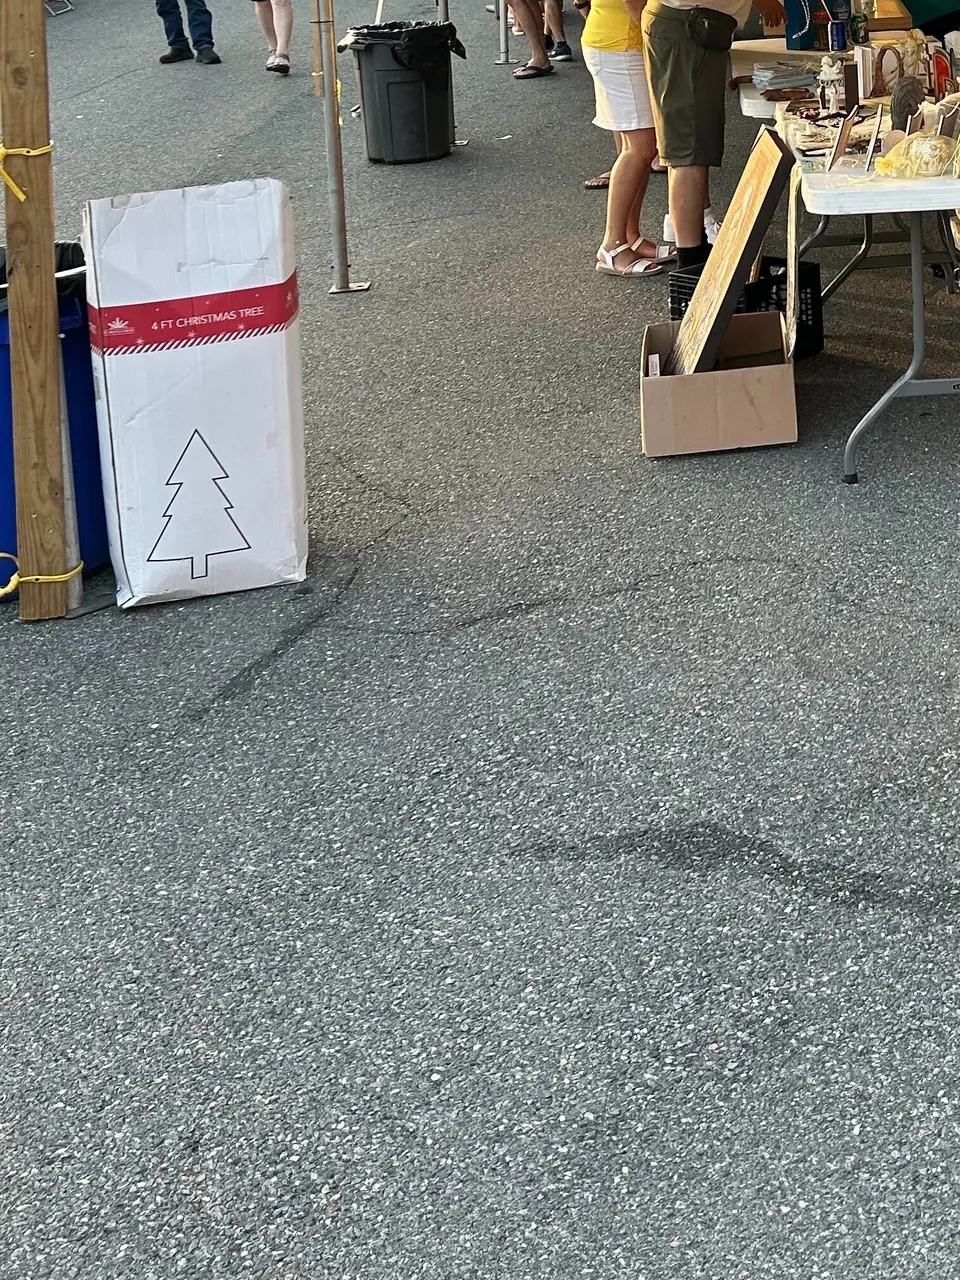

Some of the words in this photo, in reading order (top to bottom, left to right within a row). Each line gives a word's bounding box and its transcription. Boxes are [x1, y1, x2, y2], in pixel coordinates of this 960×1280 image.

[151, 322, 158, 331] 4
[161, 319, 174, 329] FT
[176, 312, 236, 328] CHRISTMAS
[238, 306, 264, 317] TREE
